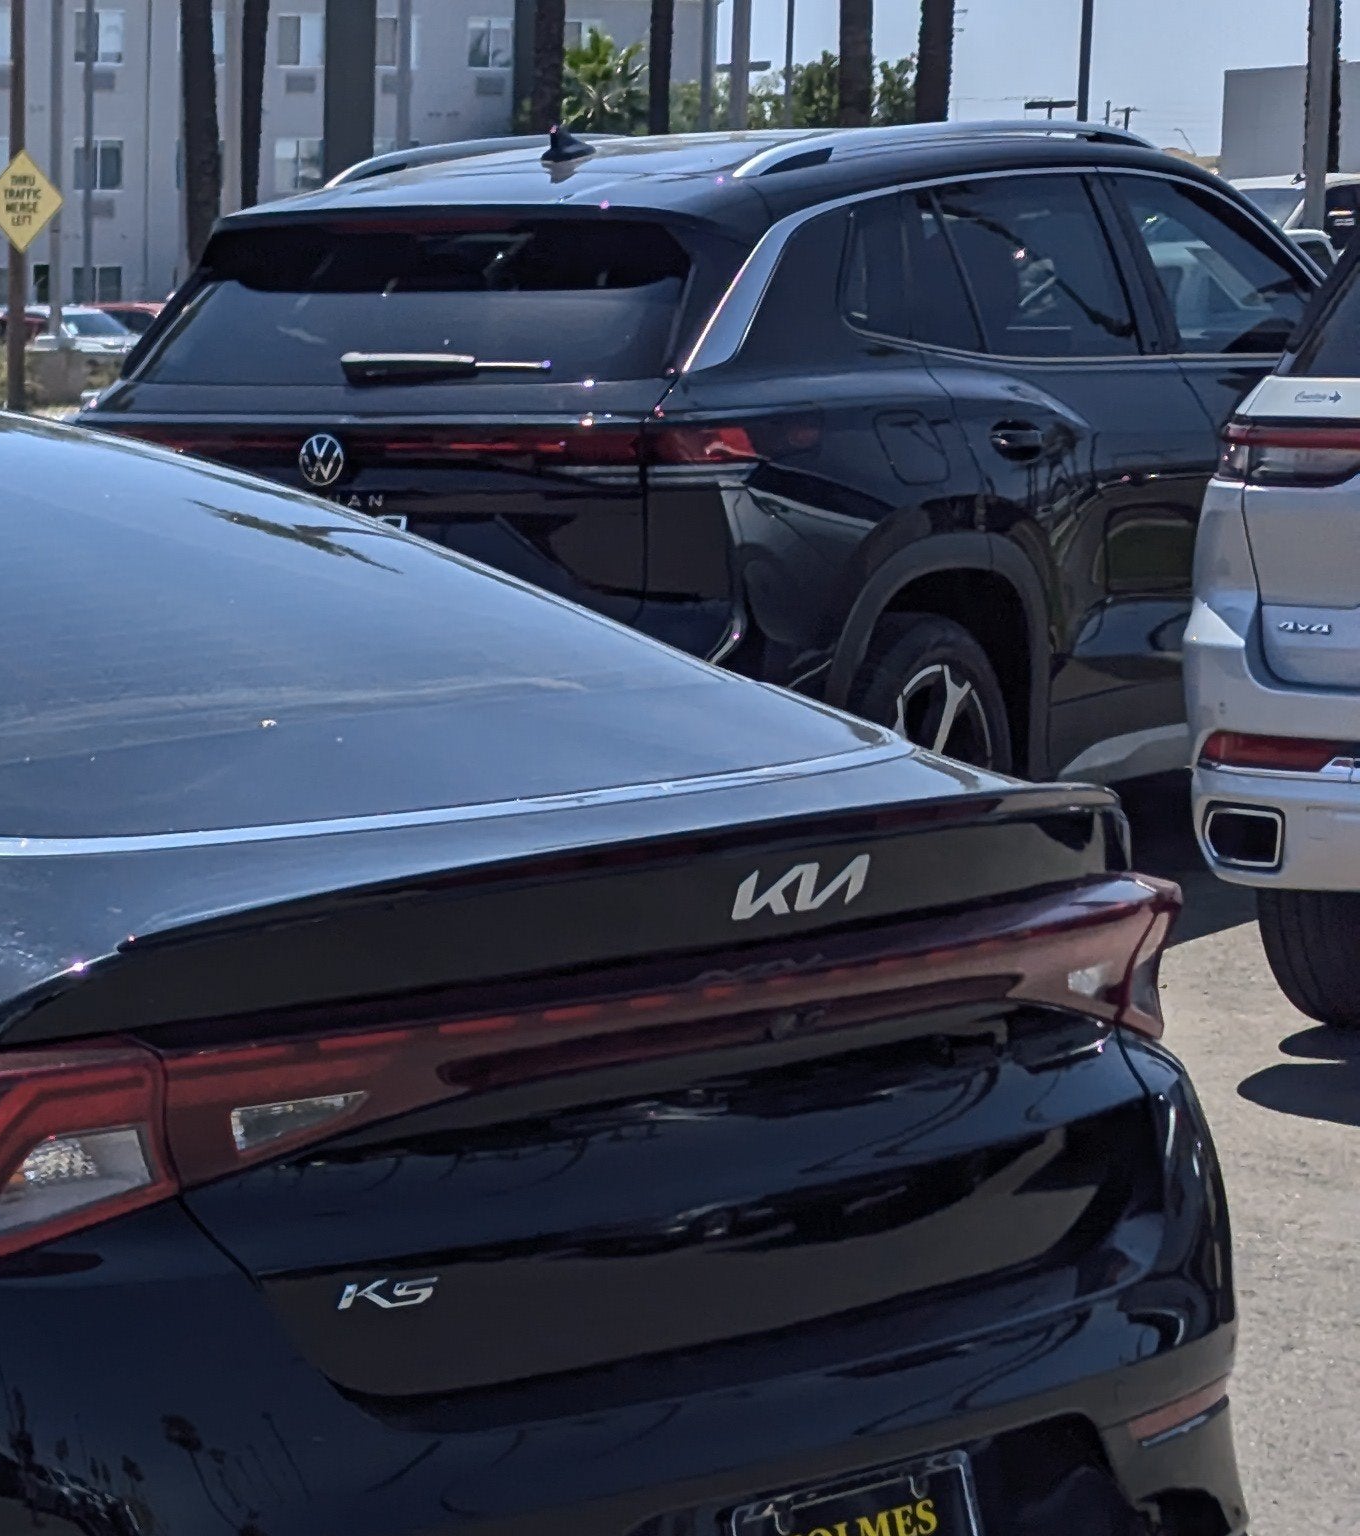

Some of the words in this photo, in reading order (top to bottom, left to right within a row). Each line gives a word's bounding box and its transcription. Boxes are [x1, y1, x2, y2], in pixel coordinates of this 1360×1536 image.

[4, 188, 42, 200] TRAFFIC
[731, 853, 871, 922] KIA
[337, 1276, 439, 1310] K5
